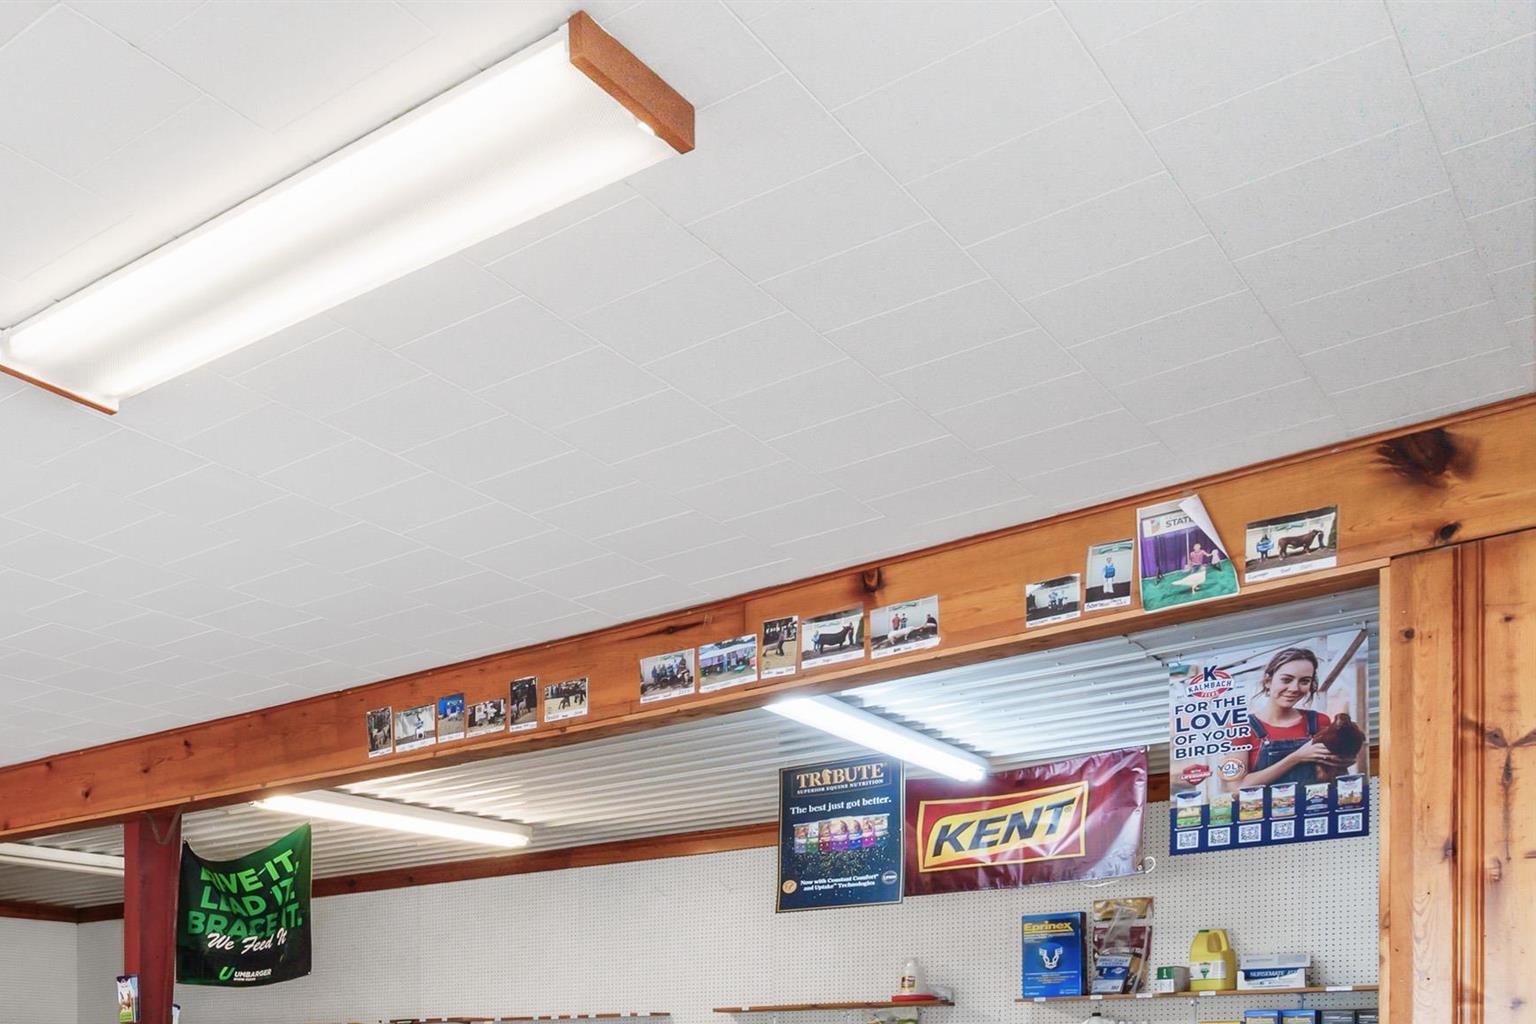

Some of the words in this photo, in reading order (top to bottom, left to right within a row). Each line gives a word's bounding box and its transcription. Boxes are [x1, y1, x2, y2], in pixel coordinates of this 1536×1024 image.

[1204, 665, 1217, 682] K
[1188, 680, 1232, 693] KALMBACH
[1175, 702, 1208, 715] FOR
[1213, 695, 1246, 709] THE
[1176, 707, 1248, 732] LOVE
[1175, 734, 1197, 745] OF
[1203, 727, 1249, 741] YOUR
[796, 786, 825, 795] SUPERIOR
[826, 783, 848, 792] EQUINE
[850, 779, 884, 788] NUTRITION
[790, 806, 807, 815] The
[808, 804, 826, 813] best
[827, 802, 844, 812] just
[846, 799, 861, 809] got
[862, 796, 892, 806] better.
[932, 797, 1076, 857] KENT
[265, 849, 299, 881] IT,
[188, 910, 278, 938] BRACE
[281, 902, 302, 929] IT.
[1024, 921, 1073, 931] Eprinex
[207, 933, 235, 950] We
[241, 935, 273, 954] Feed
[277, 928, 287, 945] It
[234, 968, 272, 978] UMBARGER
